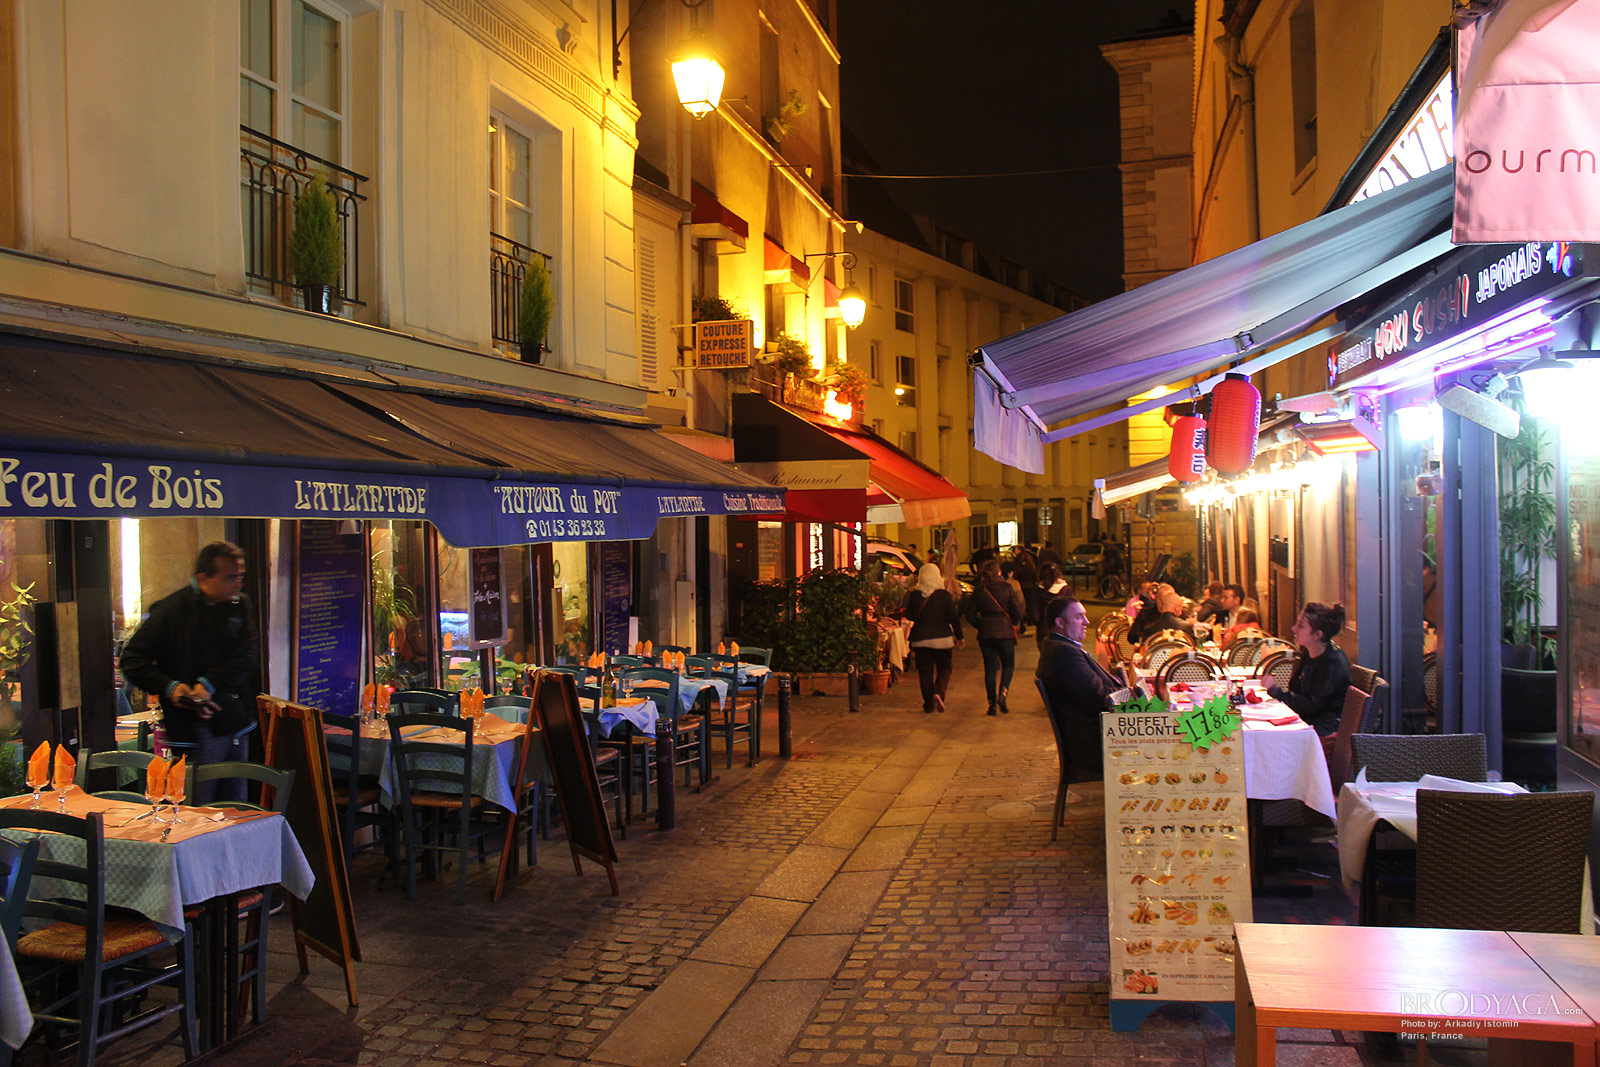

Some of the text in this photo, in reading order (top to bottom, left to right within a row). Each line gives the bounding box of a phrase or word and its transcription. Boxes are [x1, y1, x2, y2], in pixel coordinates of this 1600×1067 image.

[1413, 273, 1470, 343] SUSHI
[1476, 242, 1541, 303] JAPONAIS
[703, 323, 743, 337] COUTURE
[700, 338, 746, 351] EXPRESSE
[700, 352, 747, 365] RETOUCHE
[0, 457, 224, 509] Feu de Bois
[770, 470, 843, 486] Restaurant
[294, 480, 427, 514] L'ATLANTIDE
[570, 489, 589, 514] du
[539, 520, 552, 537] 01
[567, 519, 580, 536] 36
[581, 519, 594, 536] 23
[1118, 716, 1168, 727] BUFFET
[1106, 727, 1116, 737] A
